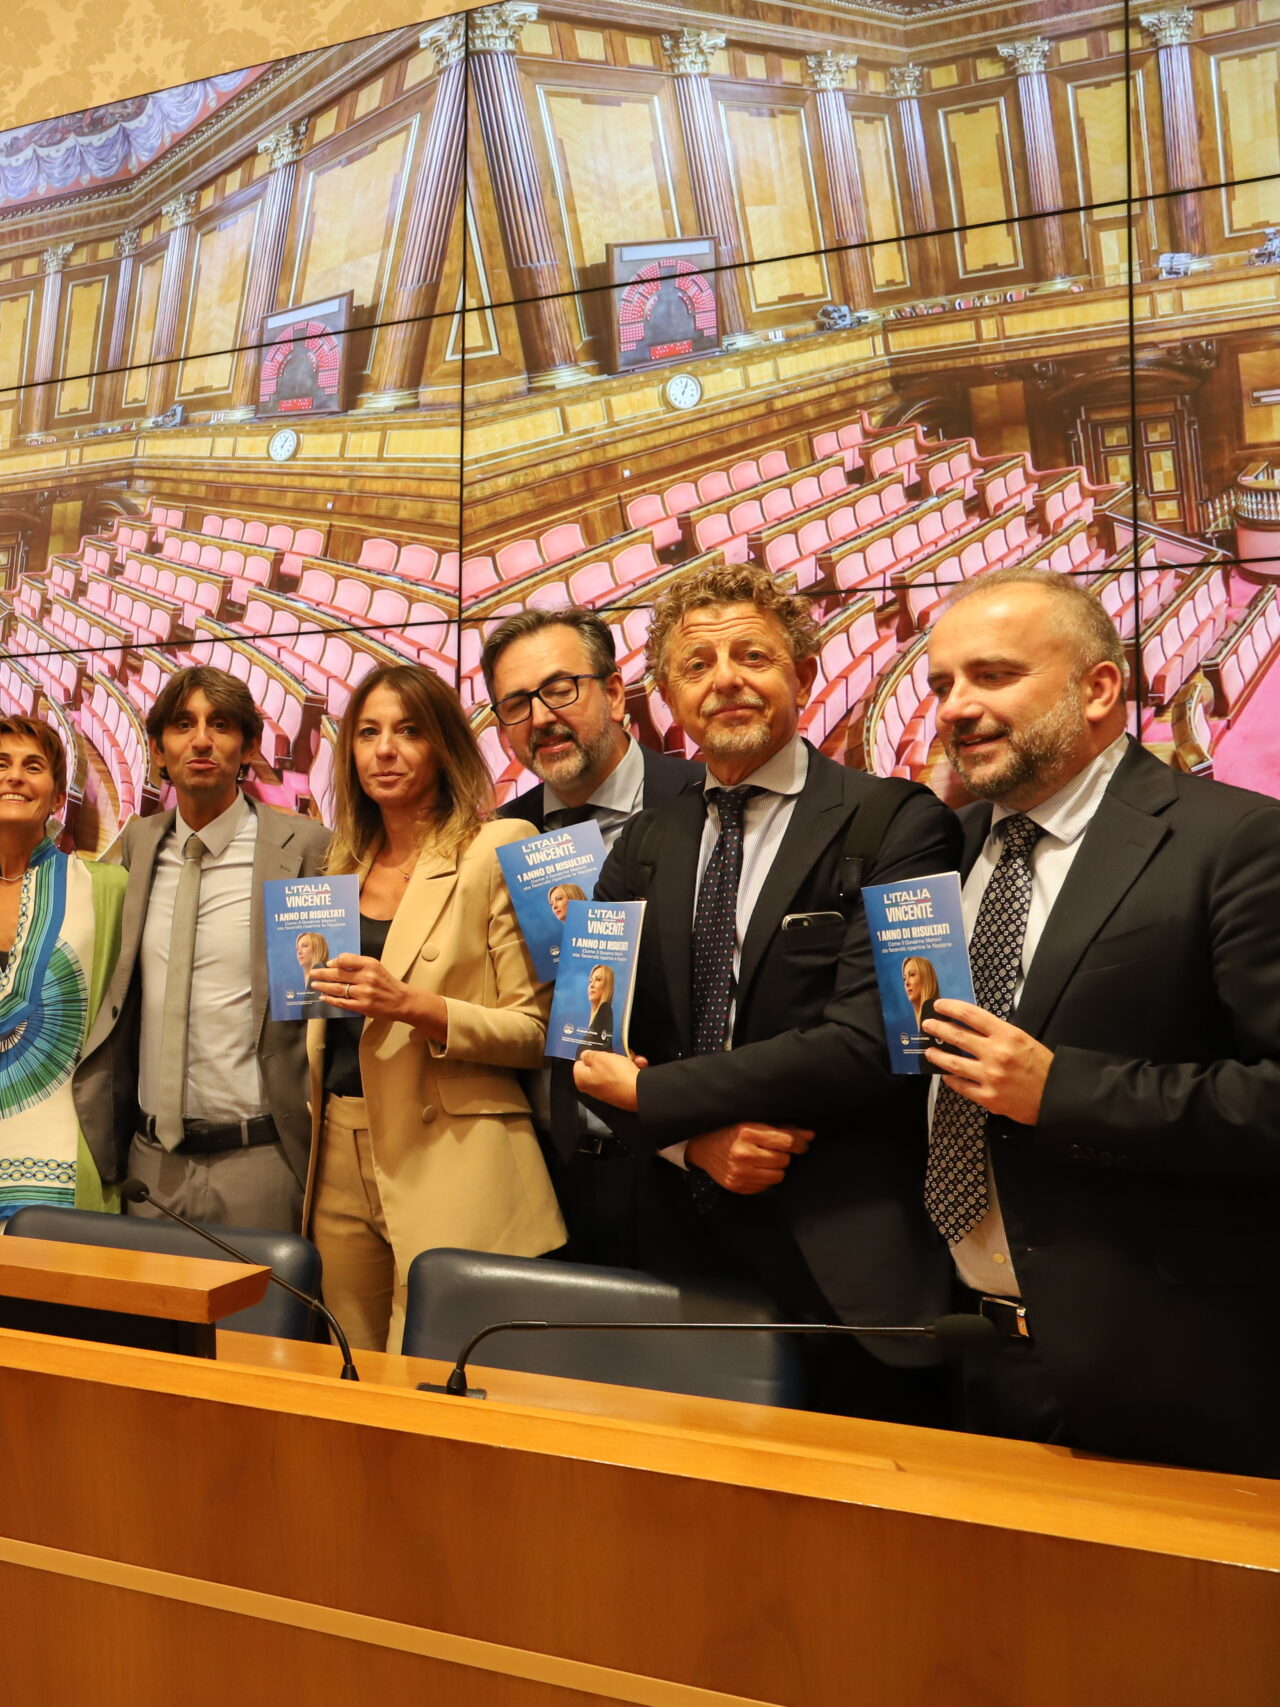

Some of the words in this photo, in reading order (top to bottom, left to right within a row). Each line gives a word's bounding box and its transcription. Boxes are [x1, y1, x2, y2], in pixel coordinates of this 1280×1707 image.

[521, 833, 572, 853] L'ITALIA
[525, 842, 576, 866] VINCENTE
[522, 868, 547, 882] ANNO
[547, 865, 555, 874] DI
[555, 854, 594, 872] RISULTATI
[285, 883, 331, 894] L'ITALIA
[883, 888, 931, 904] L'ITALIA
[285, 894, 332, 908] VINCENTE
[279, 911, 299, 922] ANNO
[300, 911, 308, 920] DI
[309, 909, 345, 919] RISULTATI
[588, 908, 626, 920] L'ITALIA
[885, 902, 934, 923] VINCENTE
[587, 920, 625, 936] VINCENTE
[881, 928, 902, 942] ANNO
[902, 927, 910, 938] DI
[911, 923, 950, 938] RISULTATI
[576, 938, 598, 949] ANNO
[599, 940, 607, 950] DI
